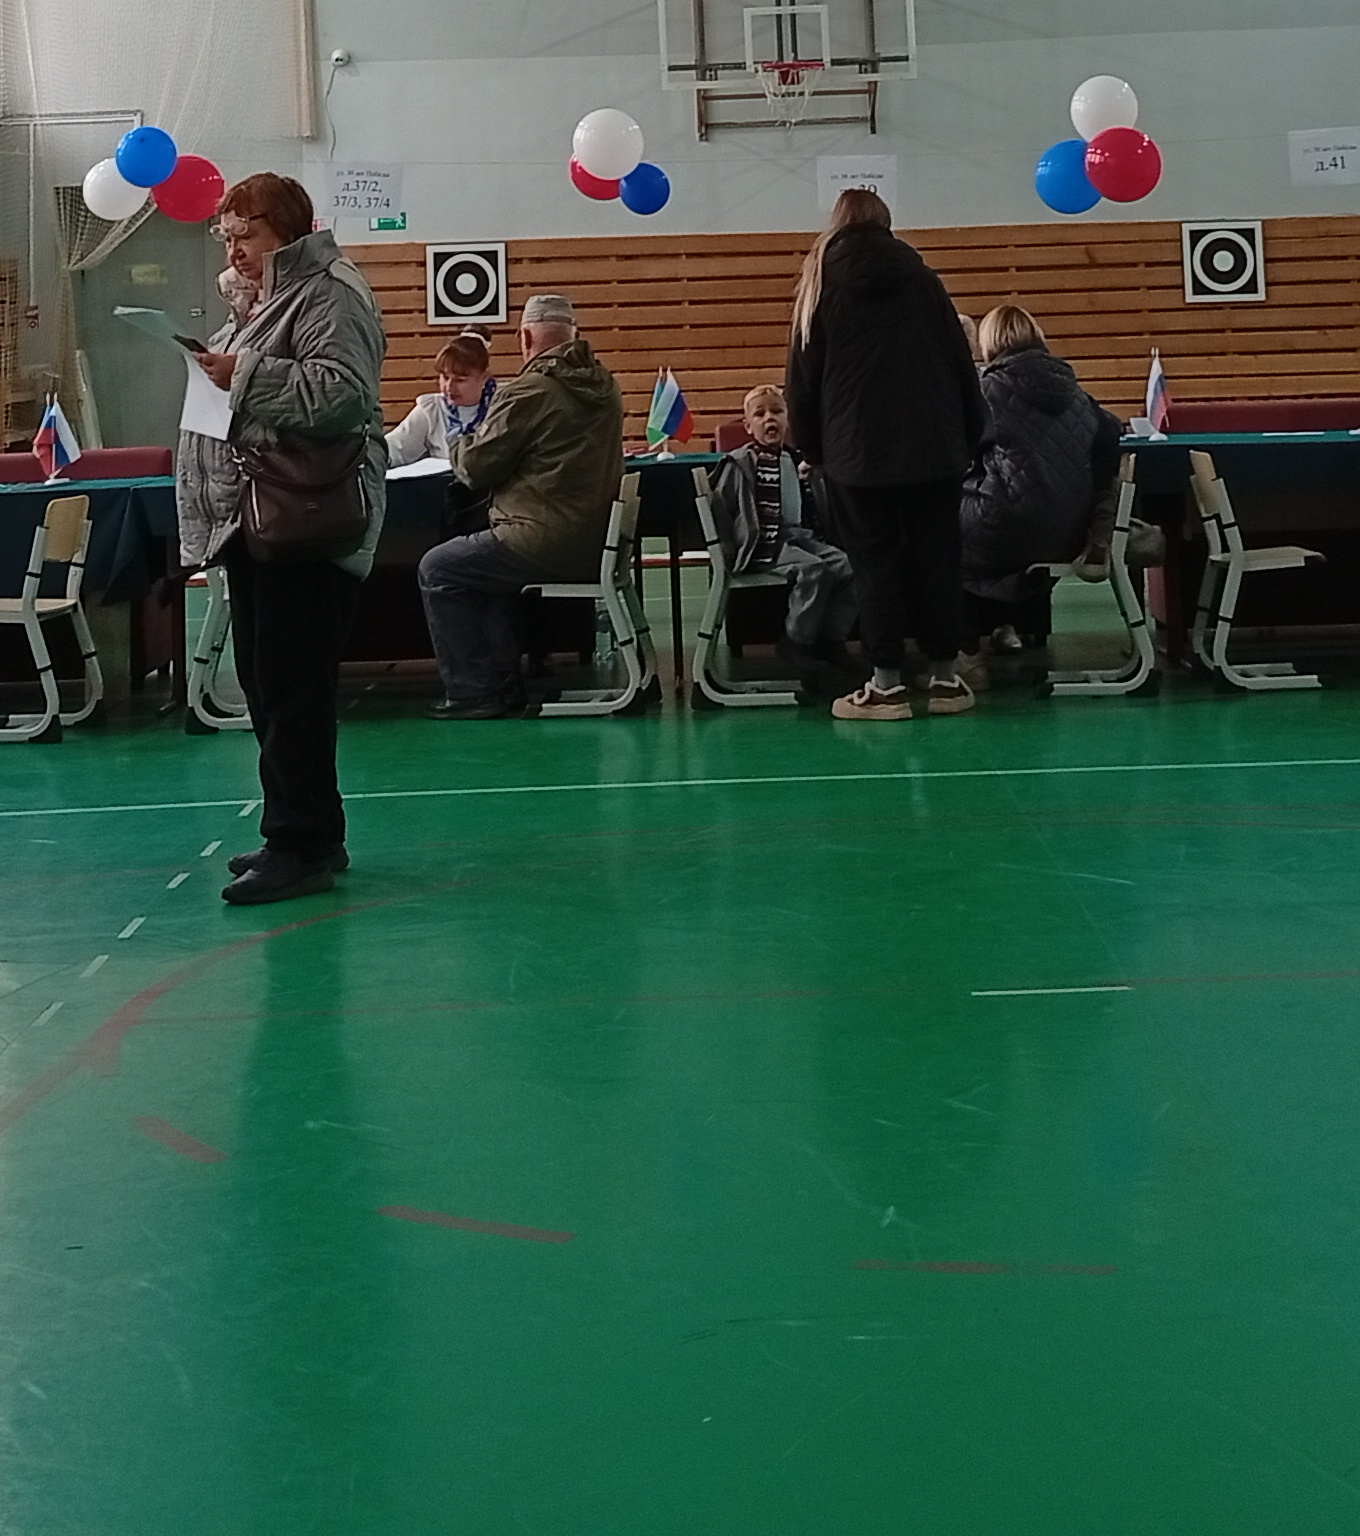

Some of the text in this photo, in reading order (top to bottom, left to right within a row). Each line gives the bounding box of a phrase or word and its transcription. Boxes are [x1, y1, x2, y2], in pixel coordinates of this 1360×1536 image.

[1315, 155, 1346, 173] д.41
[342, 180, 382, 193] д.37/2,
[333, 196, 390, 209] 37/3, 37/4
